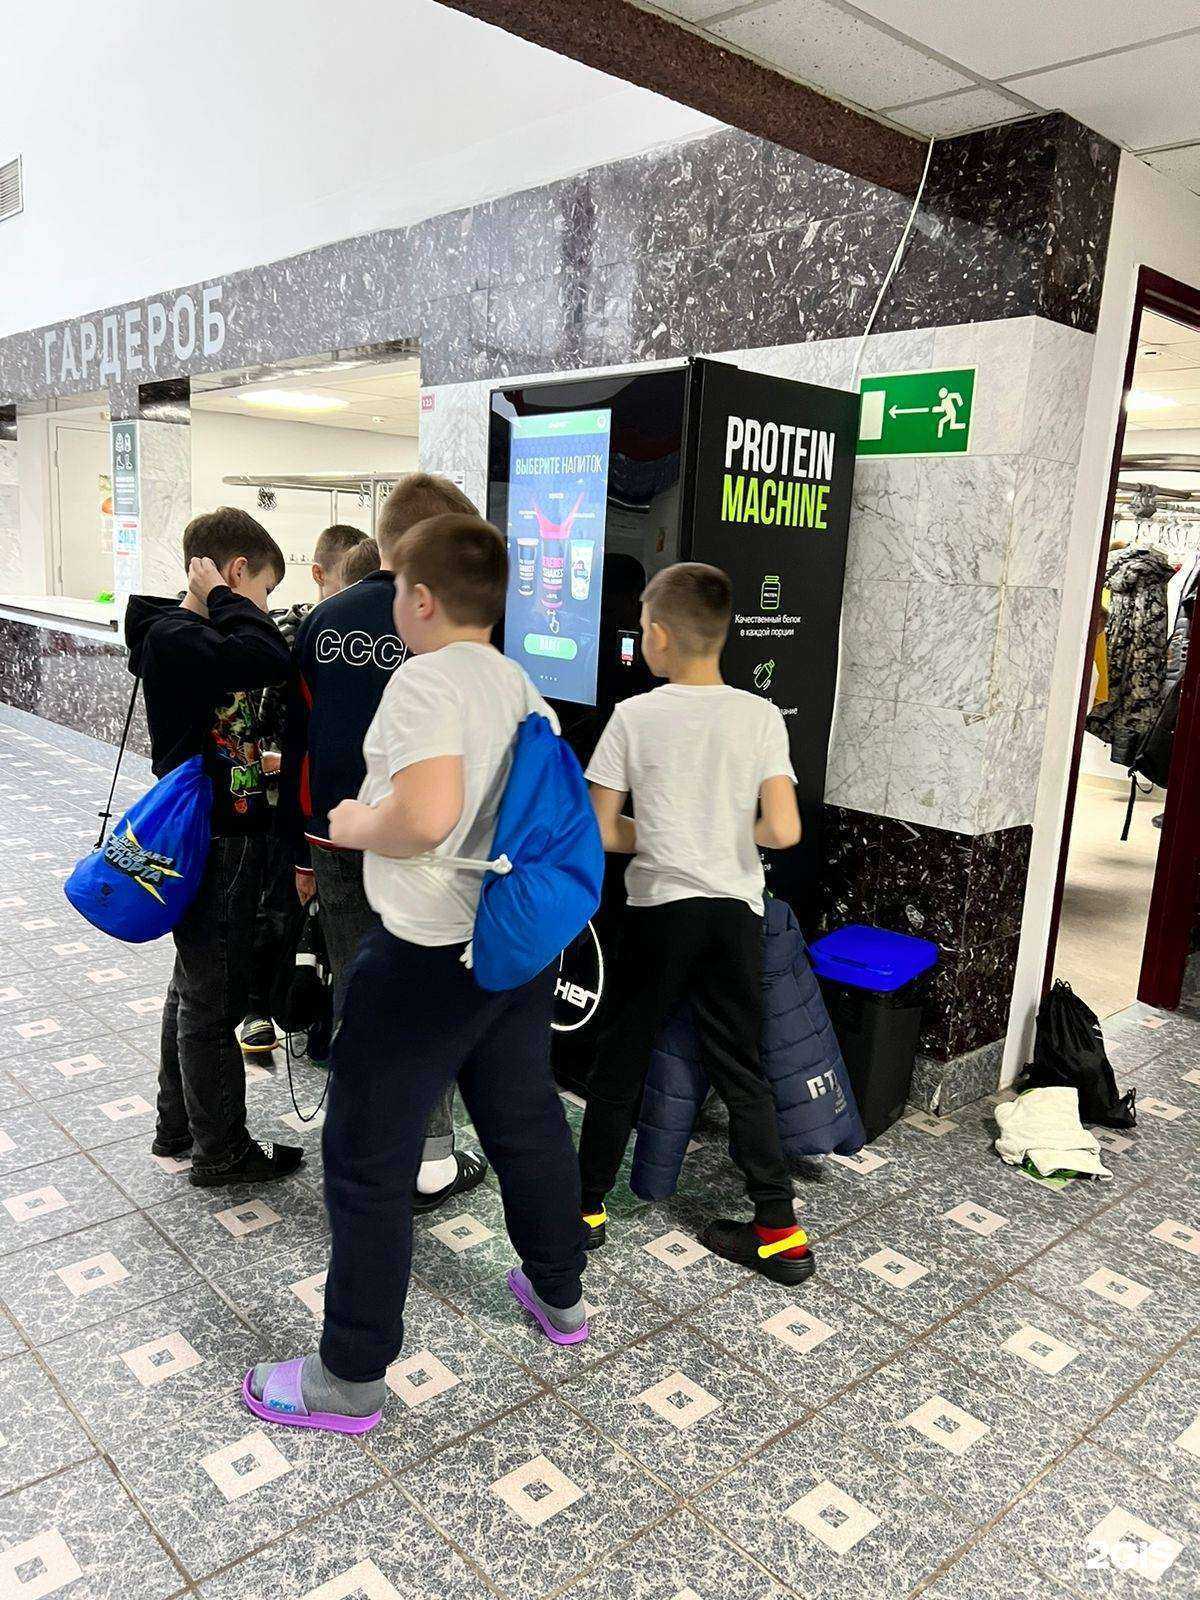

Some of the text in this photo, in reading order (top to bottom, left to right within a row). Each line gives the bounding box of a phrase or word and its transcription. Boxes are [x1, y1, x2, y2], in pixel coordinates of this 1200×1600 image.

[44, 285, 226, 385] ГАРДЕРОБ
[515, 454, 603, 475] ВЫБЕРИТЕ НАПИТОК
[725, 415, 835, 480] PROTEIN
[721, 474, 831, 529] MACHINE
[734, 614, 802, 624] Качественный белок
[740, 627, 795, 638] в каждой порции
[104, 845, 162, 882] СПОРТА
